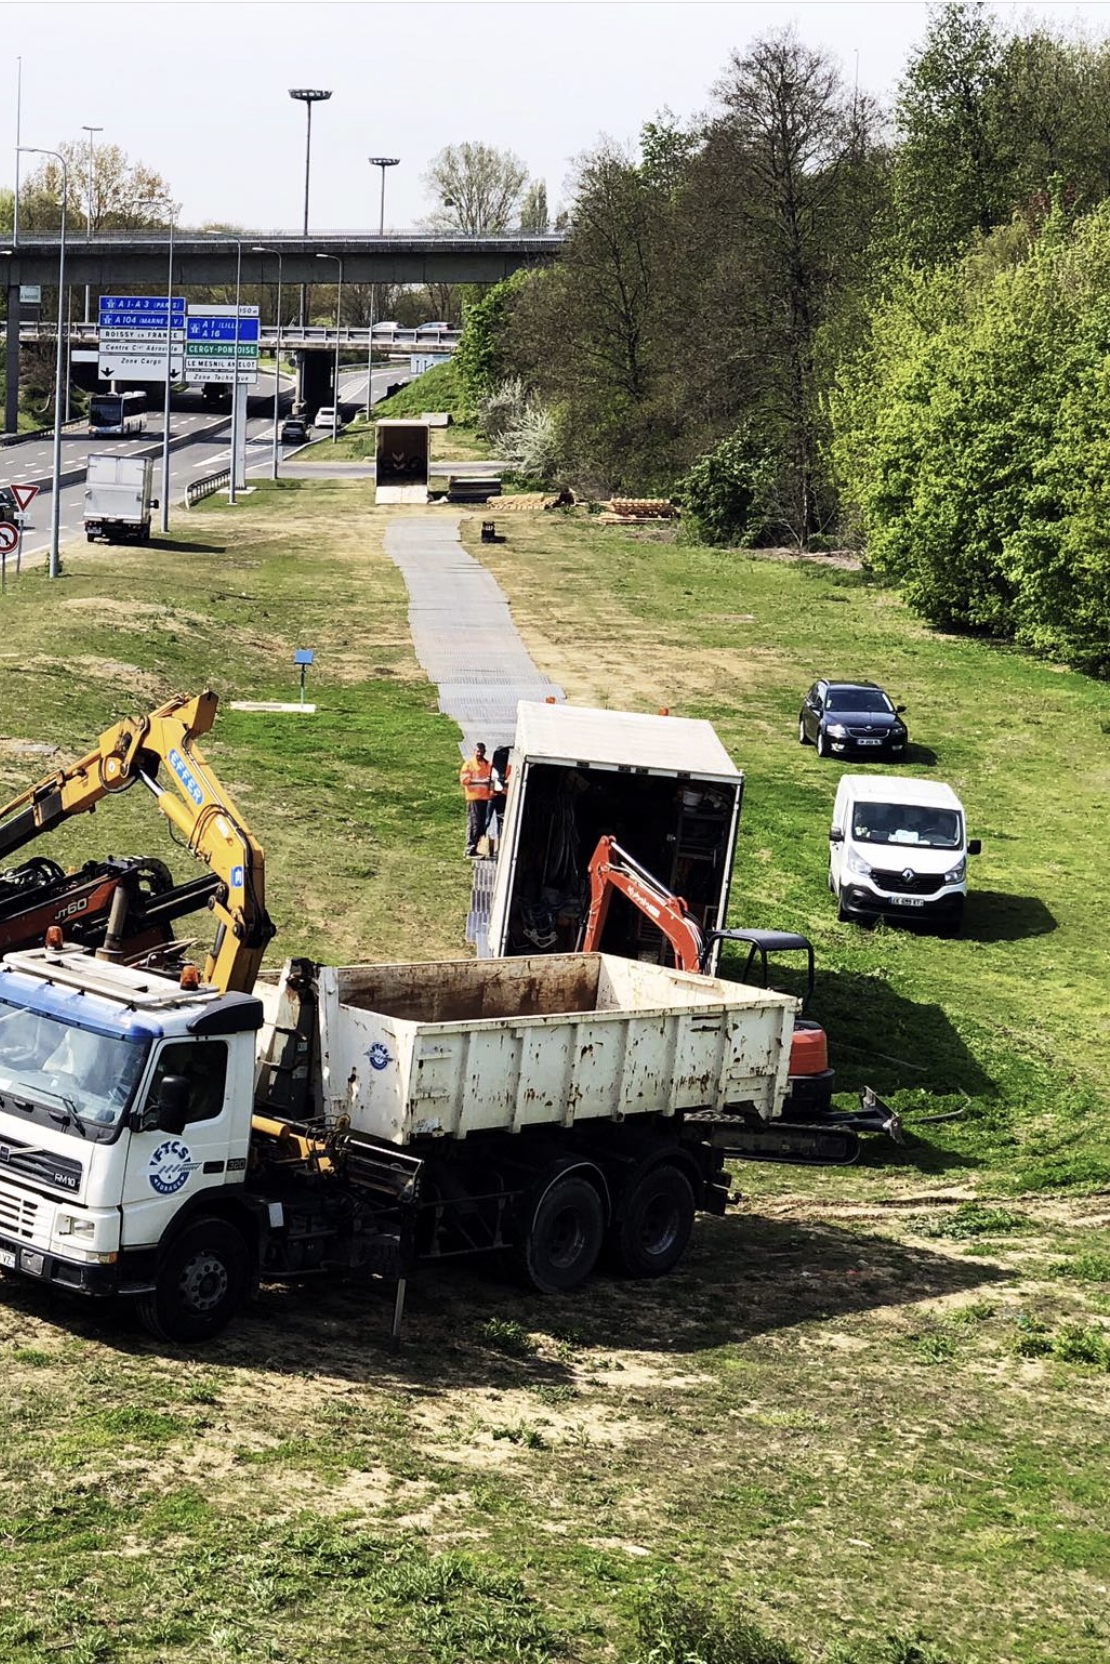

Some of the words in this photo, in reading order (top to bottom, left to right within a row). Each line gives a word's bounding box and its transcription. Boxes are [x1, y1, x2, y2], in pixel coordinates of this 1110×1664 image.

[121, 357, 138, 365] Zone
[140, 358, 162, 366] Cargo
[170, 752, 202, 804] EFFER
[54, 898, 87, 920] JT60
[153, 1140, 189, 1162] FTCS
[228, 1160, 245, 1169] 320
